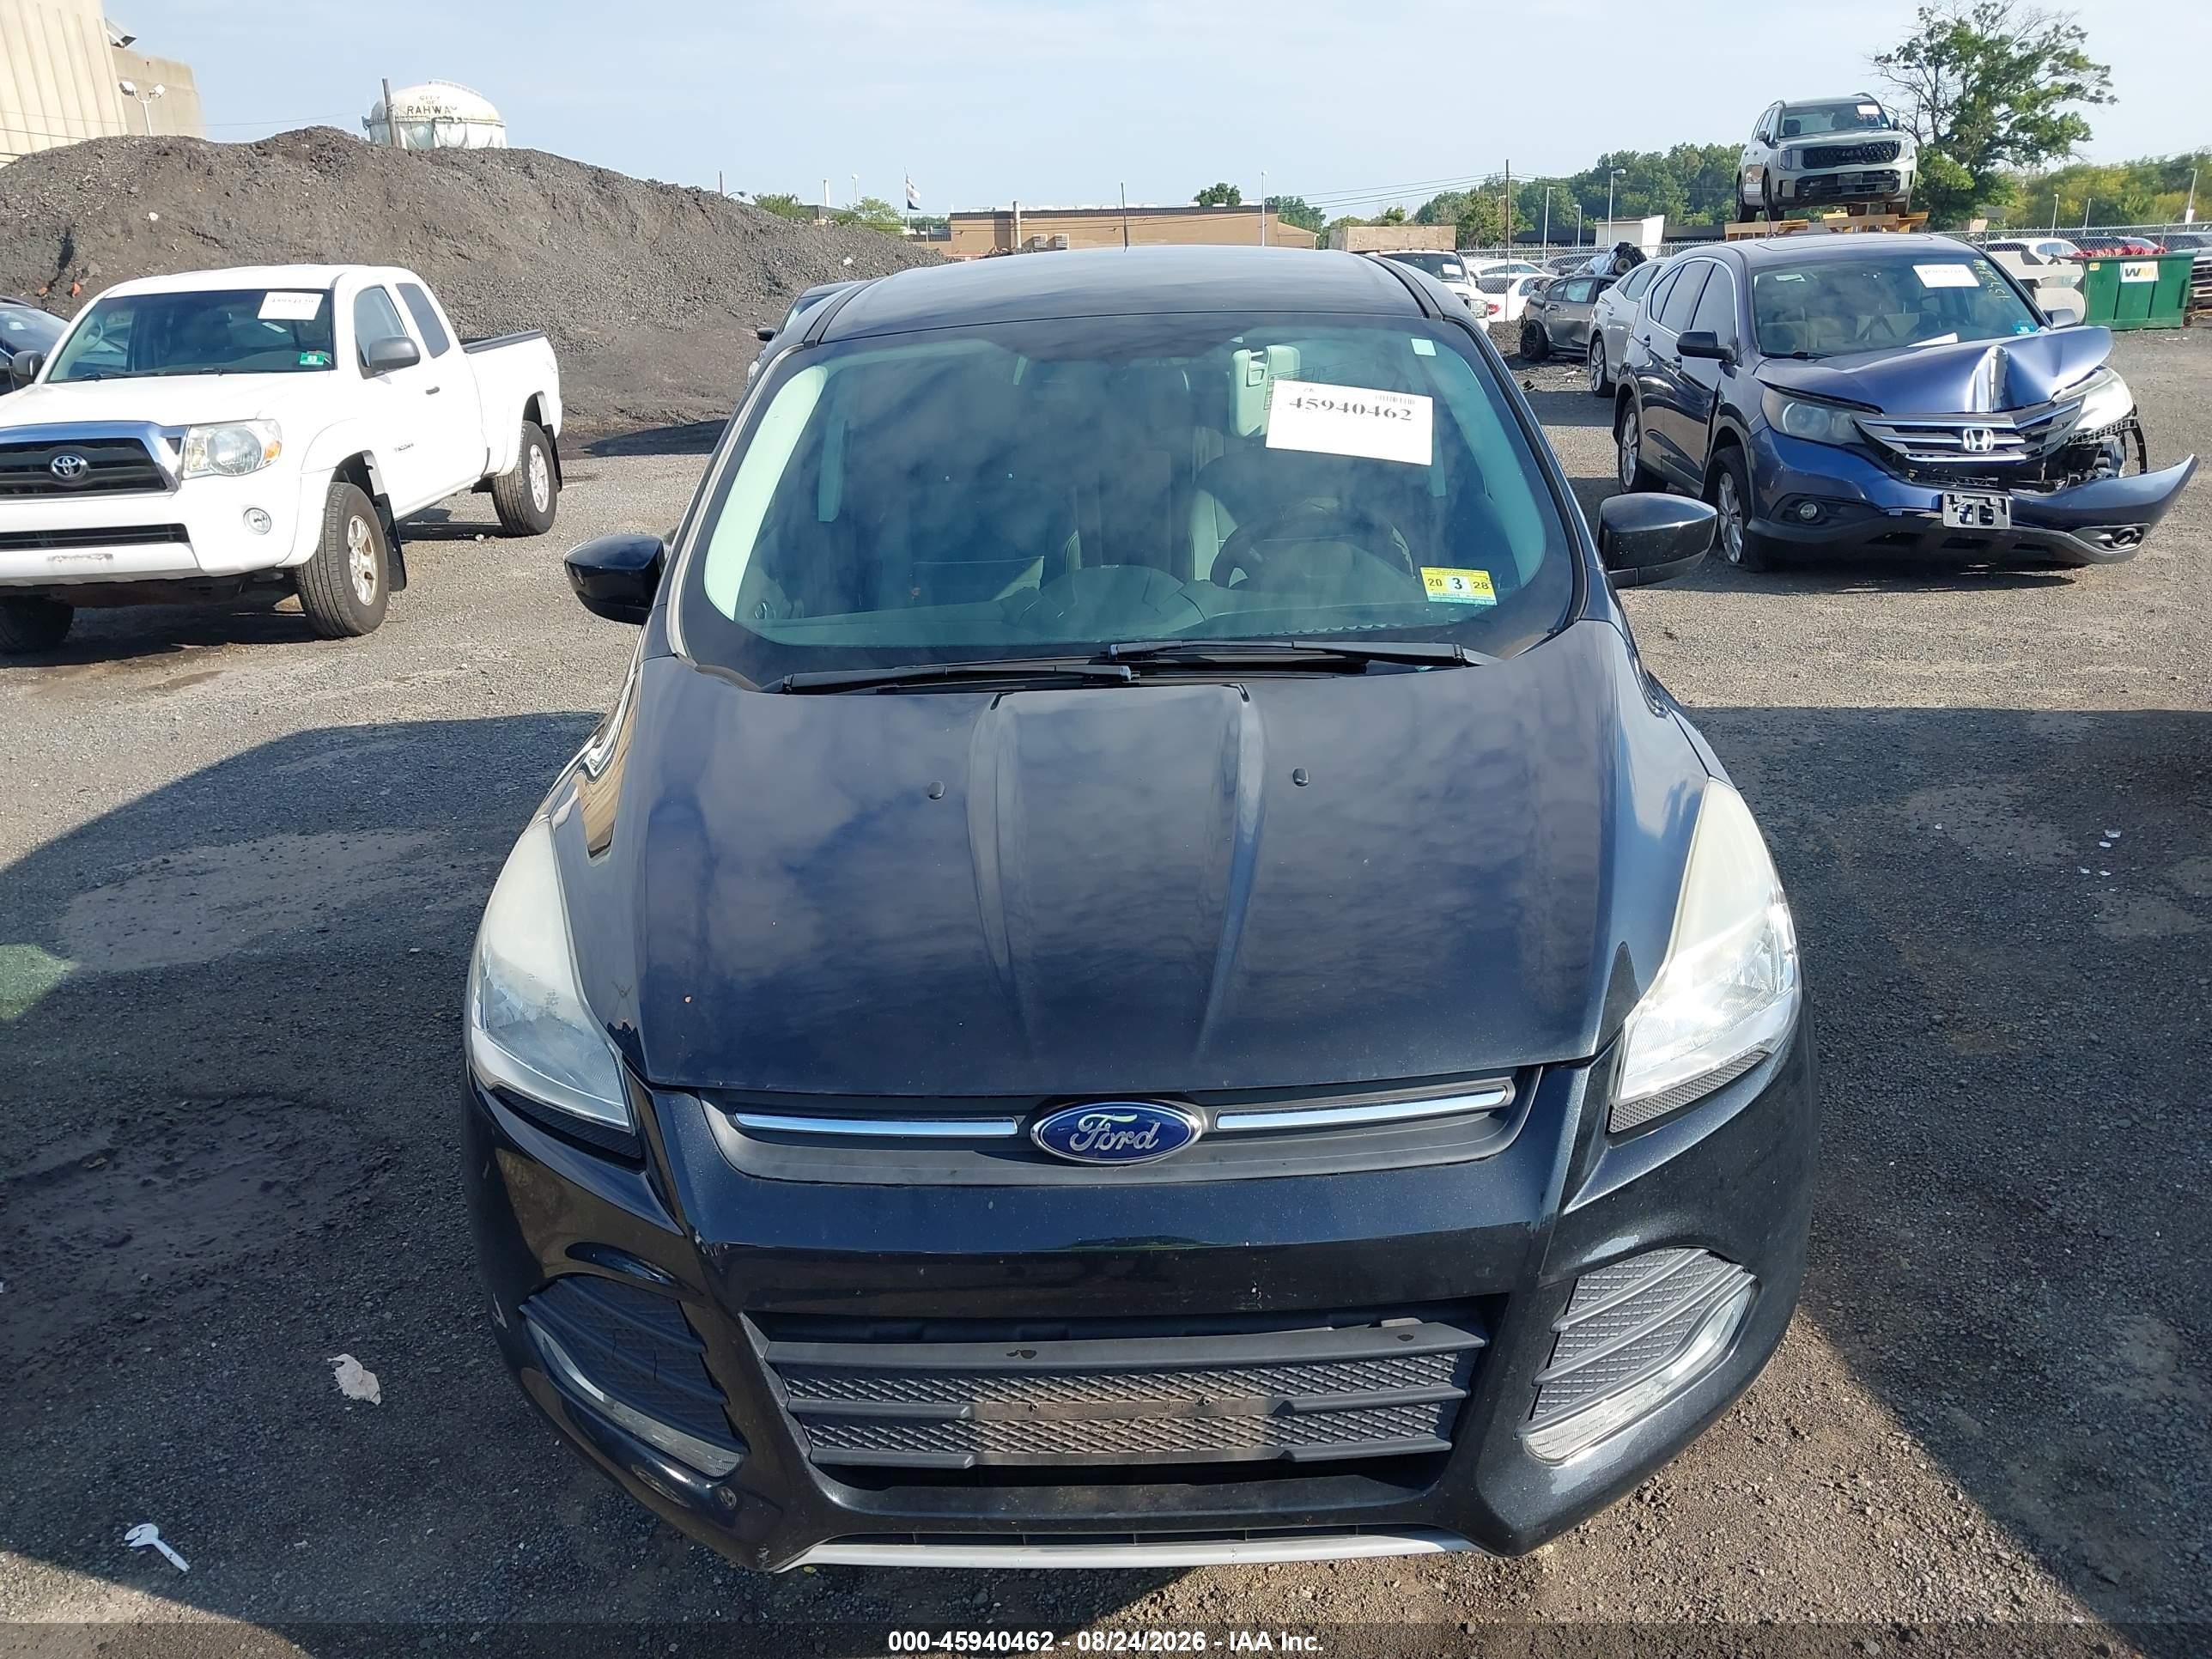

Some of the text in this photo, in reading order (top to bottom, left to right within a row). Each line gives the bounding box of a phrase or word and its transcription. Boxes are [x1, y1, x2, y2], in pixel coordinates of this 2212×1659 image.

[407, 105, 458, 114] RAHWAY
[1289, 397, 1413, 421] 45940462
[1427, 577, 1489, 590] 20 3 28
[1069, 1113, 1161, 1152] Ford
